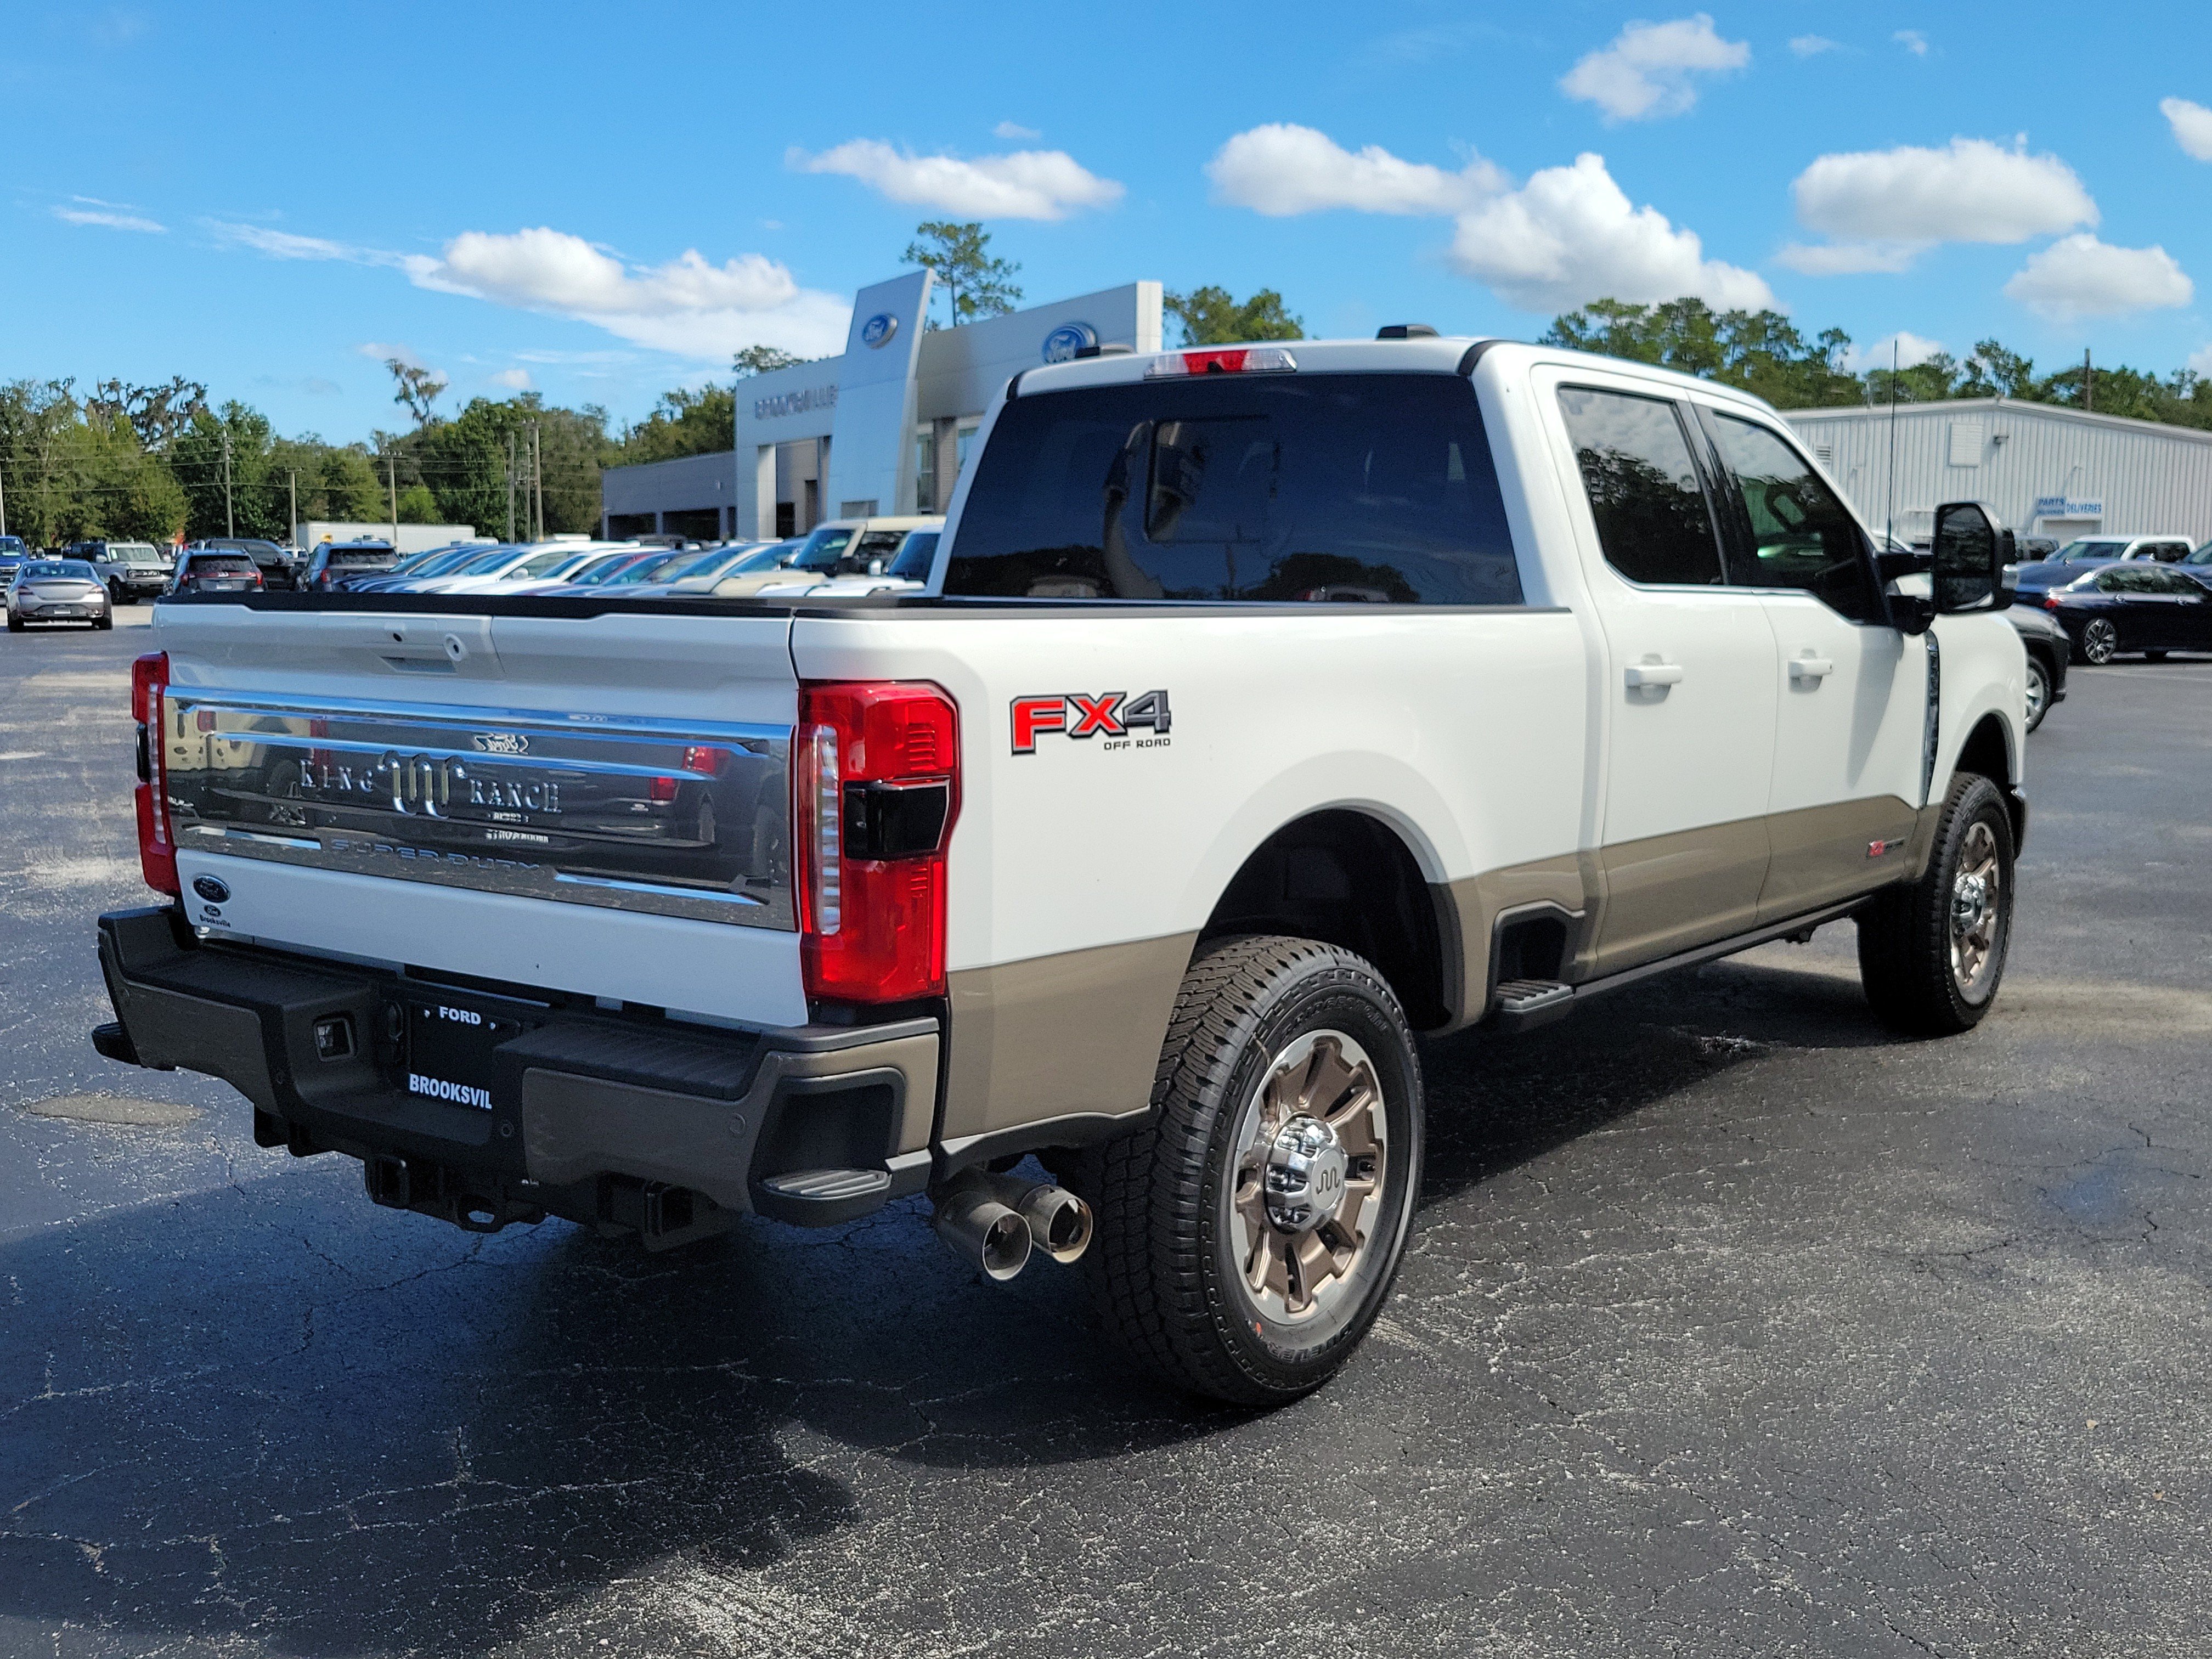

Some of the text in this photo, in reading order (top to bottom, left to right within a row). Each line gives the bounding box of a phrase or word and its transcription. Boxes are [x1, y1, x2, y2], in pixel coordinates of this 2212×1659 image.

[2066, 504, 2101, 514] DELIVERIES
[1010, 690, 1171, 756] FX4
[1104, 738, 1171, 750] OFF ROAD
[300, 758, 562, 814] KING RANCH
[330, 838, 541, 870] SUPER DUTY
[439, 1006, 481, 1025] FORD
[409, 1073, 492, 1110] BROOKSVIL
